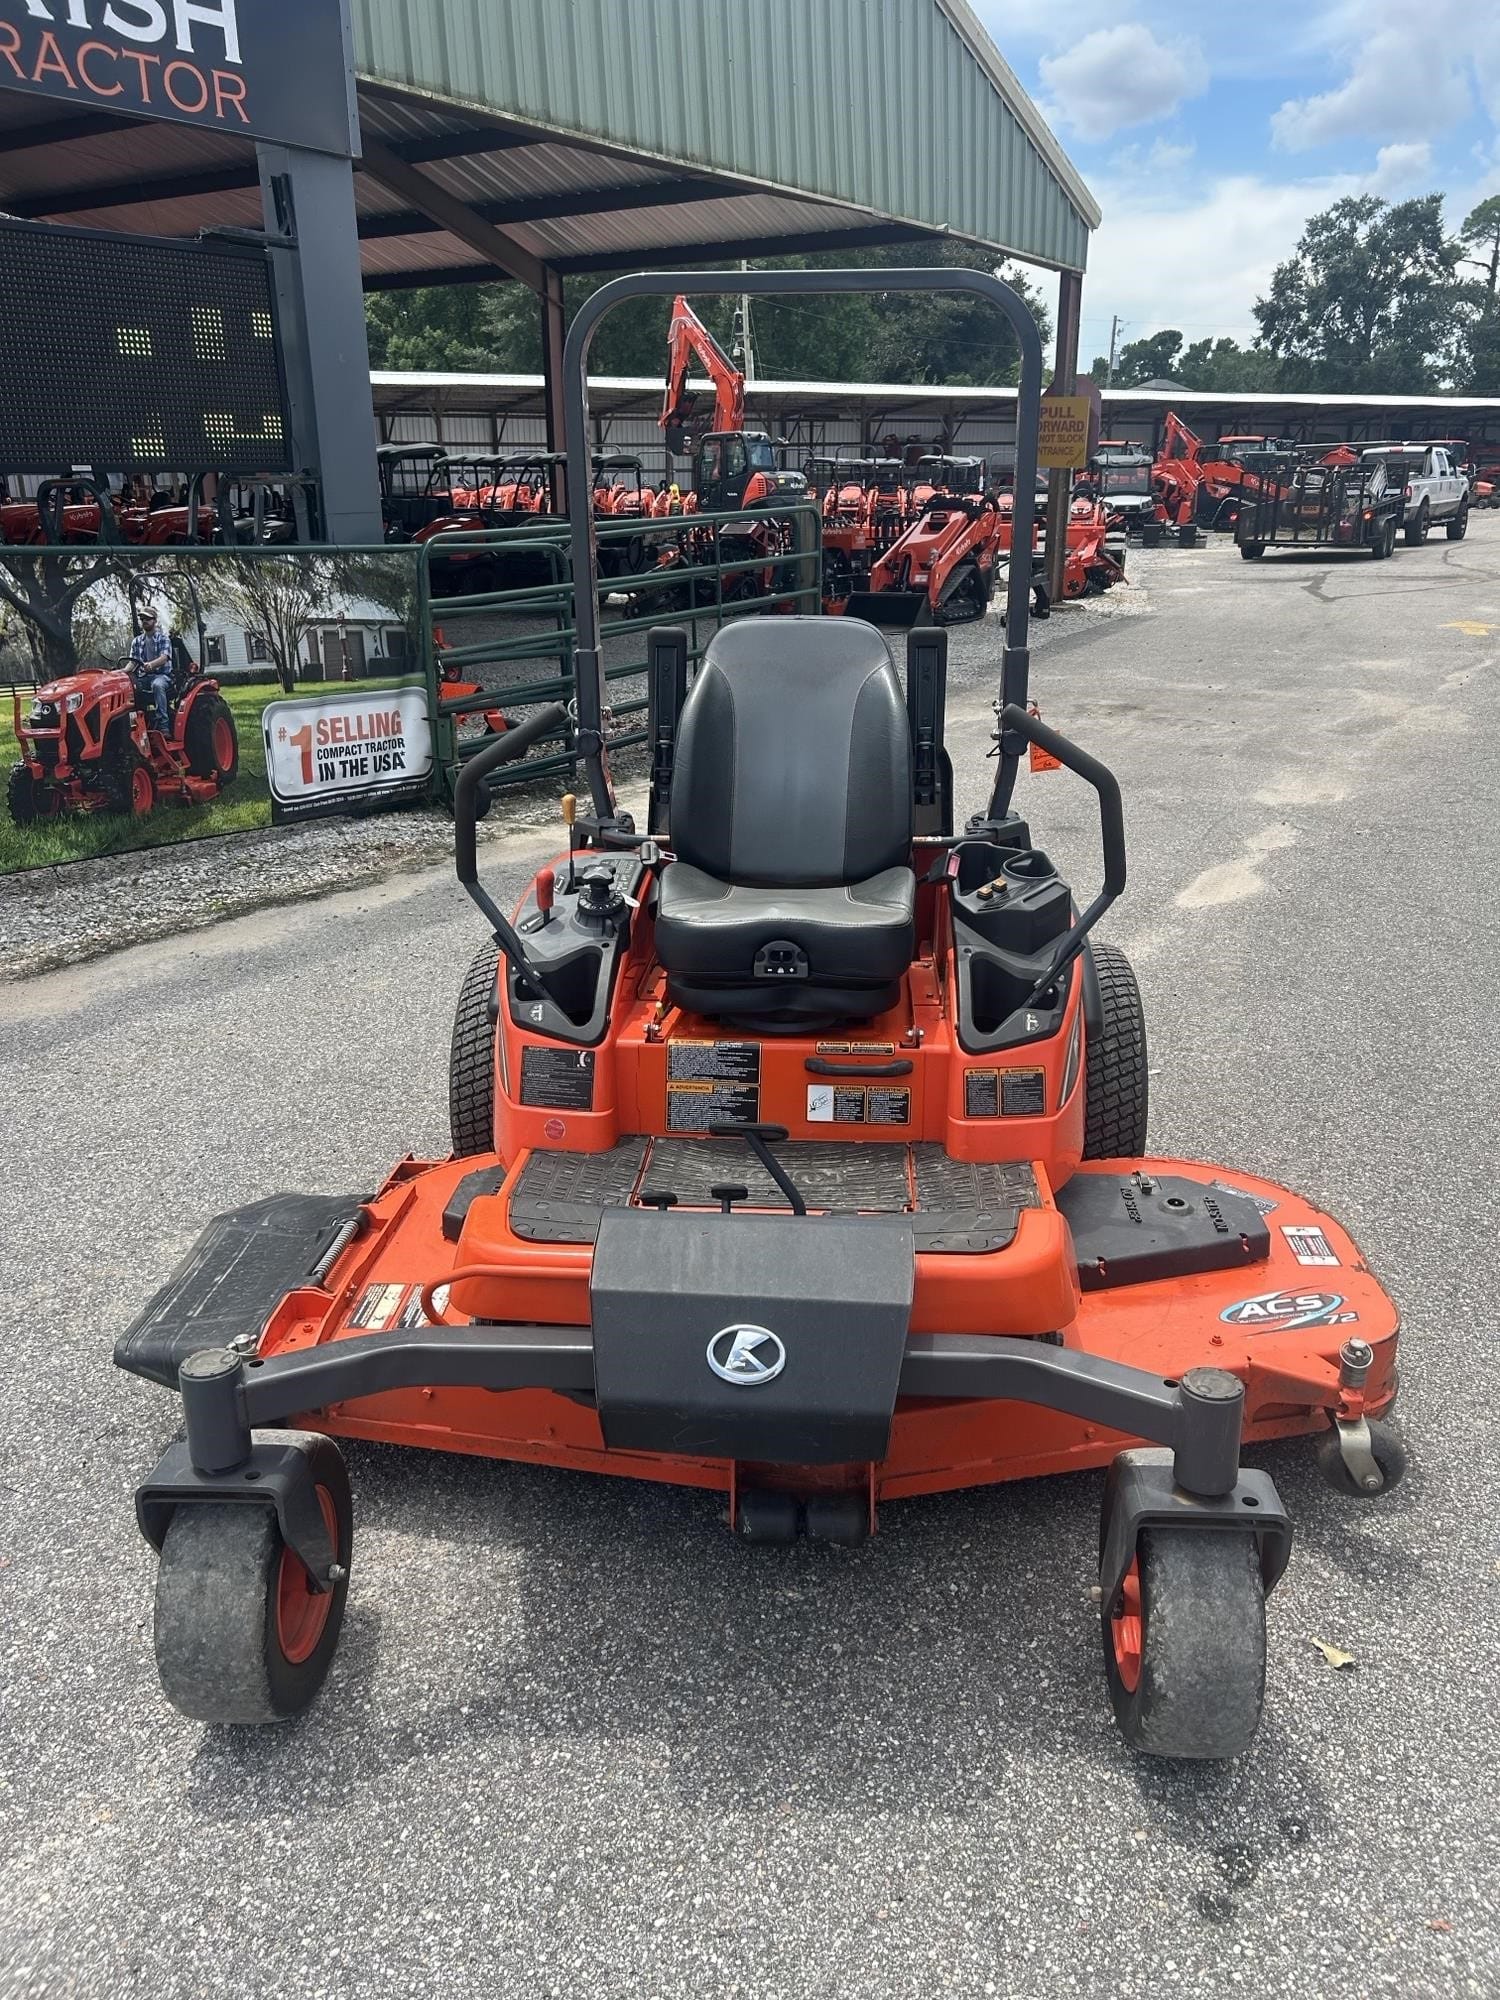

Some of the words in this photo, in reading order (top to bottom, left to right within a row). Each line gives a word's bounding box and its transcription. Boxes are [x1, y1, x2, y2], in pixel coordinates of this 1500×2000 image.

[1040, 406, 1075, 418] PULL
[316, 710, 403, 746] SELLING
[317, 744, 362, 761] COMPACT
[365, 737, 406, 757] TRACTOR
[318, 762, 336, 782] IN
[339, 757, 369, 778] THE
[1238, 1294, 1324, 1319] ACS
[1322, 1312, 1358, 1325] 72
